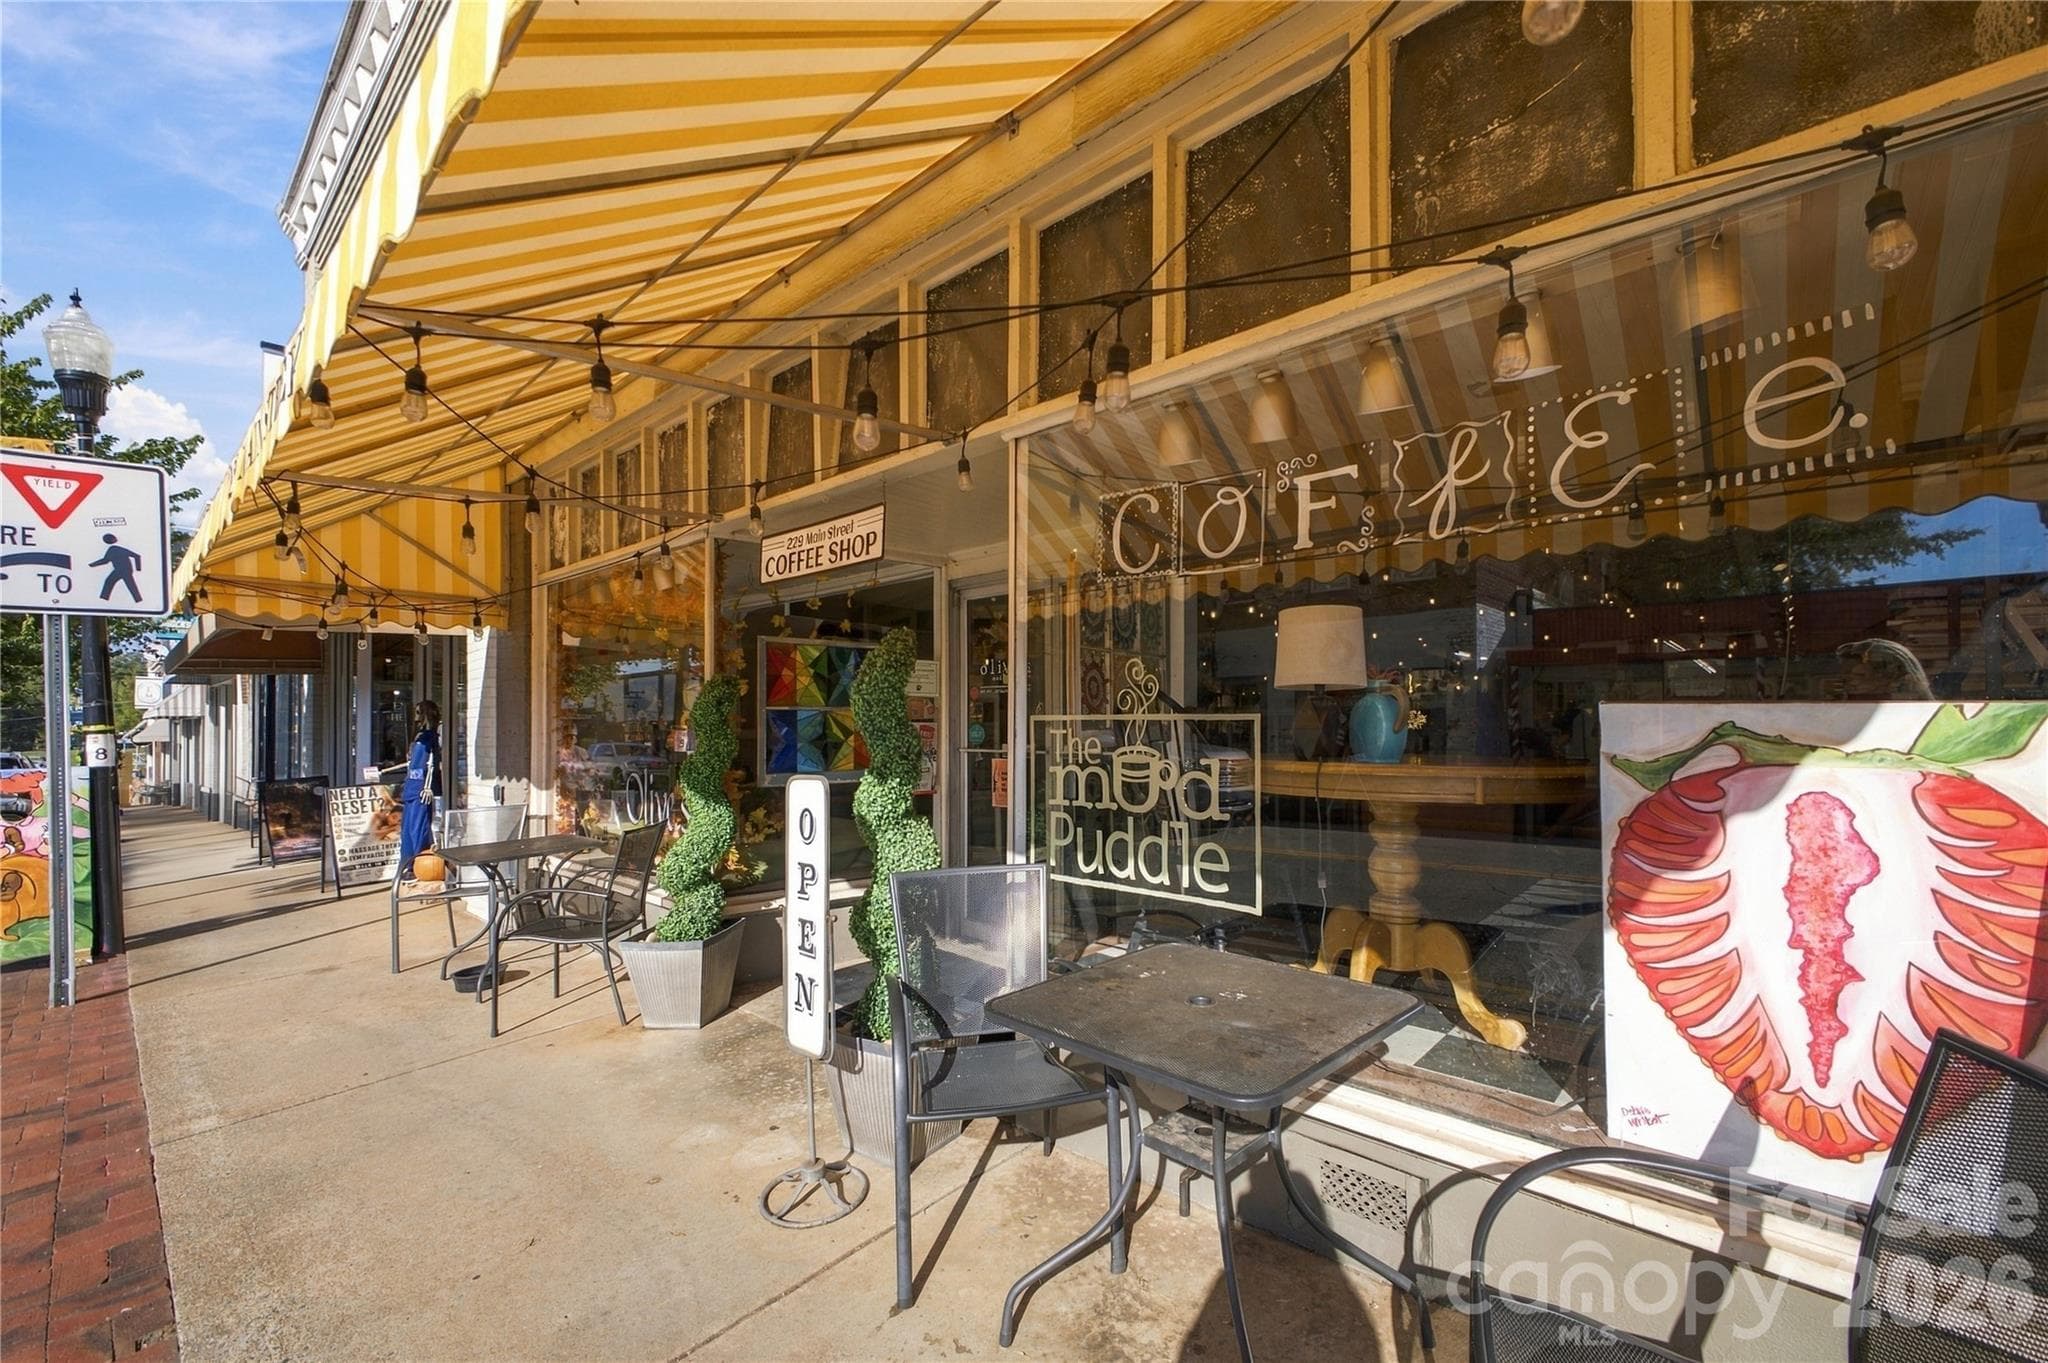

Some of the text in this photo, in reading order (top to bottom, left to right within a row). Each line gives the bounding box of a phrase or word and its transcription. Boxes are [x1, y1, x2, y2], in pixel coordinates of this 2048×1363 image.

[33, 477, 72, 490] YIELD
[786, 519, 854, 550] 229 Main Street
[765, 531, 878, 578] COFFEE SHOP
[37, 573, 73, 594] TO
[95, 747, 108, 761] 8
[1050, 728, 1101, 765] The
[329, 786, 378, 802] NEED A
[330, 797, 385, 816] RESET?
[1049, 810, 1231, 894] Puddle
[794, 807, 818, 1016] OPEN
